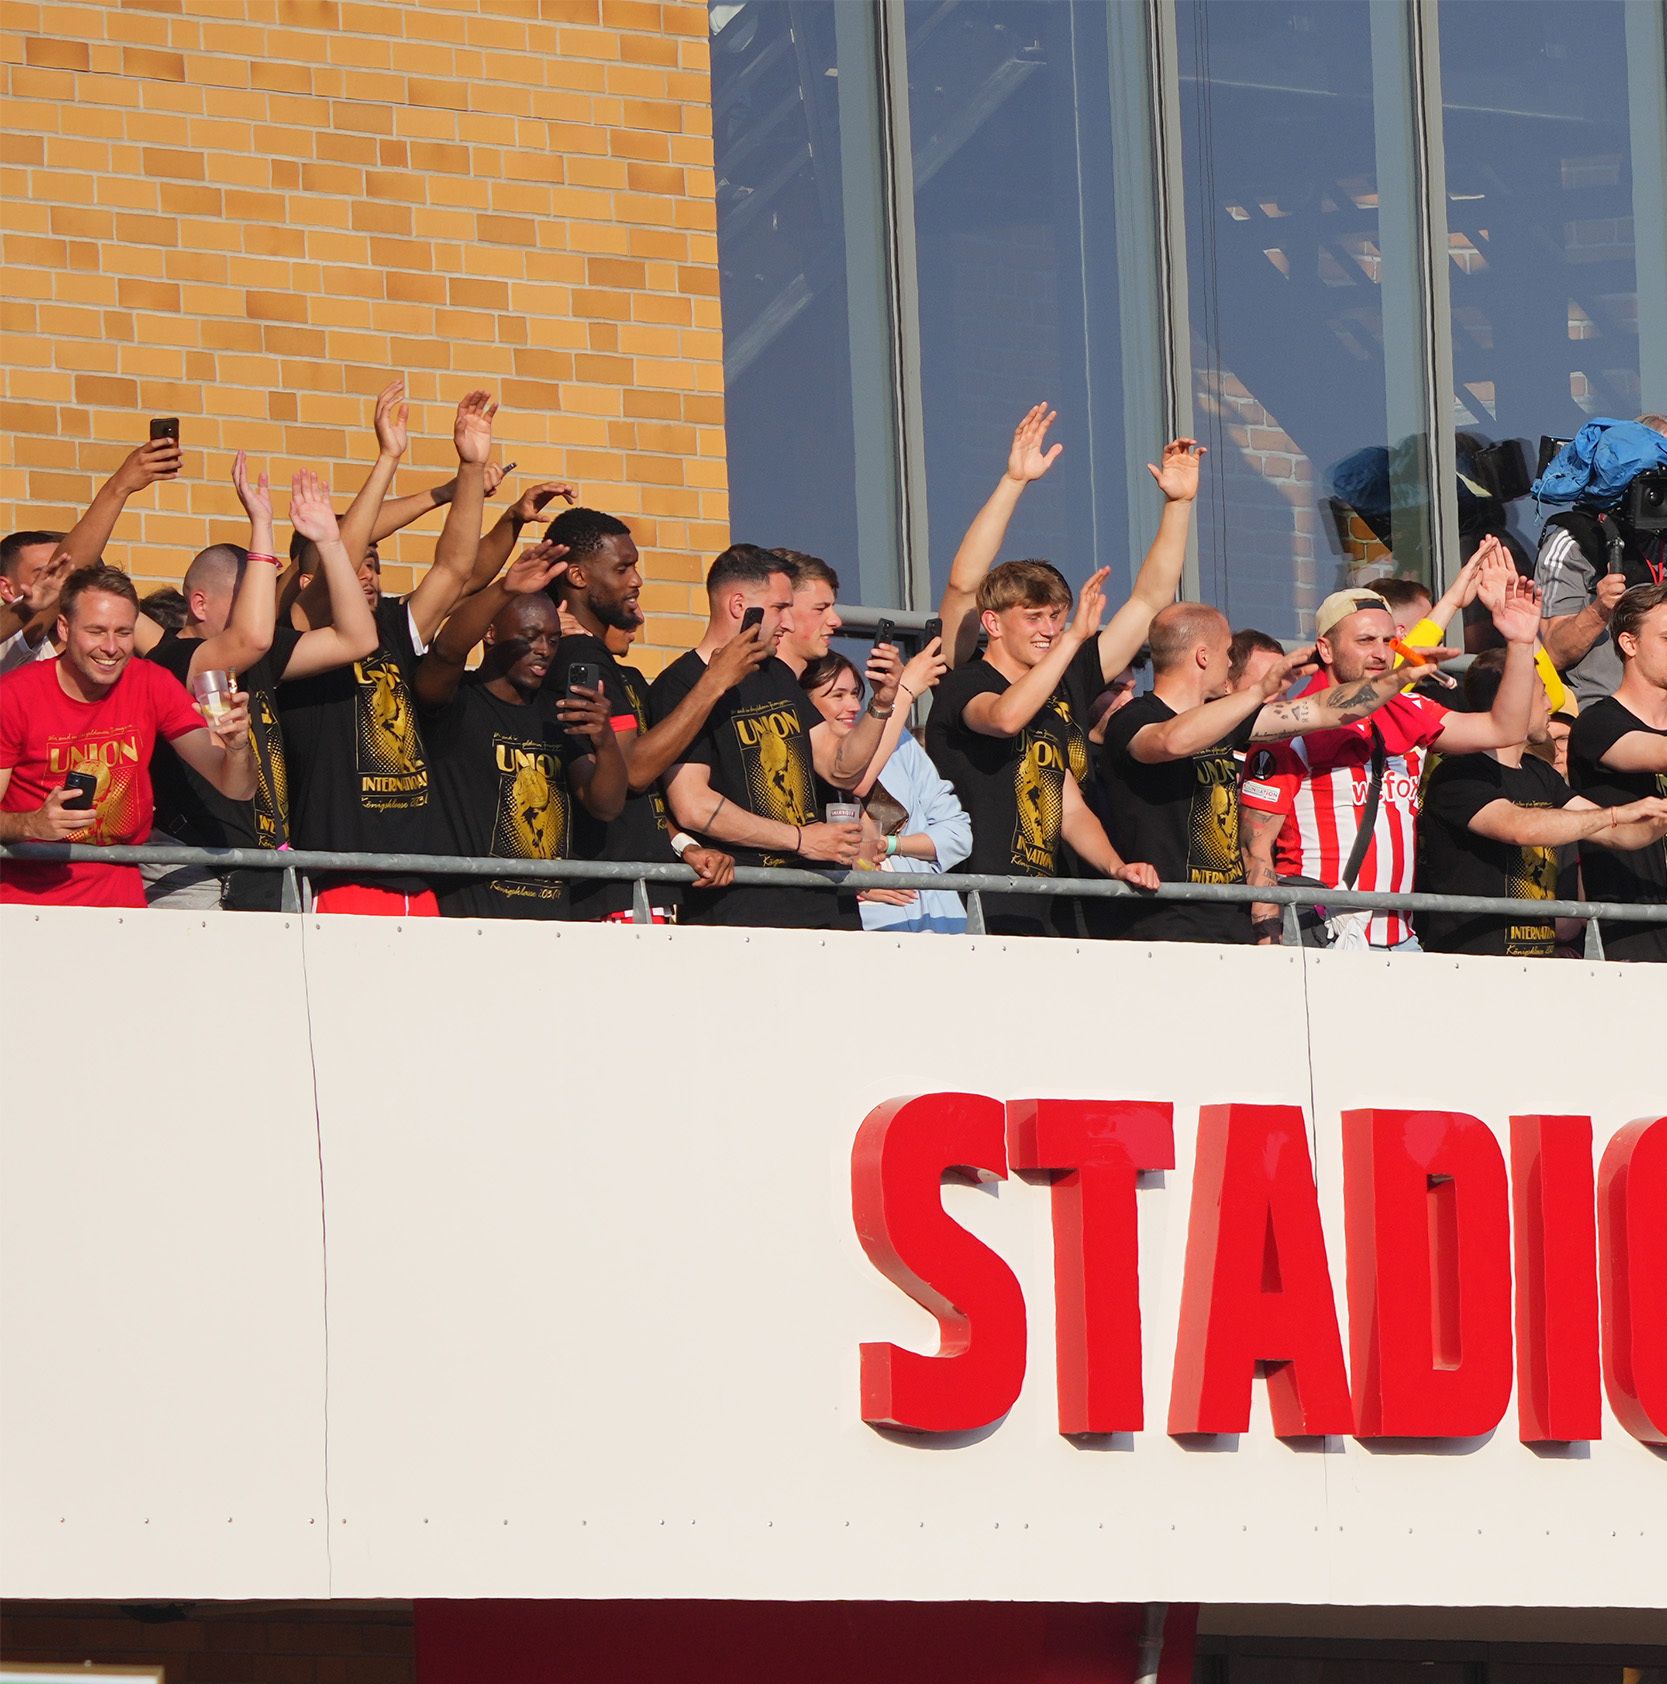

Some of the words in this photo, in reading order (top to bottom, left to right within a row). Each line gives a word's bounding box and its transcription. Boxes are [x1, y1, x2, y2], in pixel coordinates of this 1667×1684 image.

[736, 708, 801, 745] UNION
[50, 736, 139, 774] UNION
[1351, 770, 1420, 806] wfox
